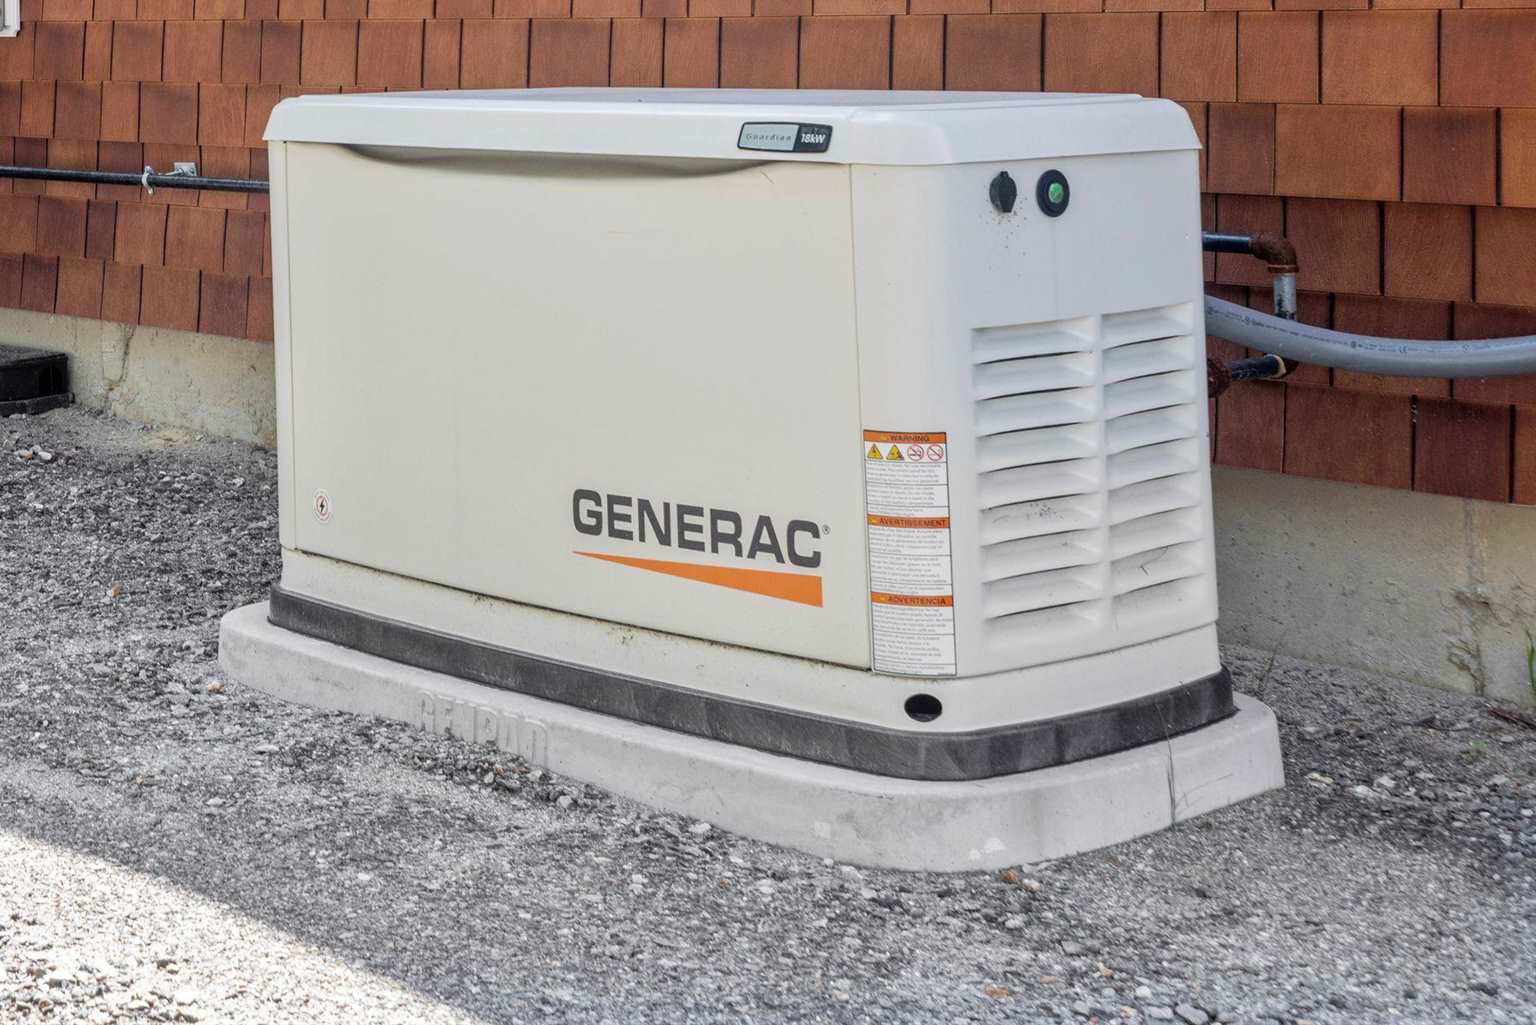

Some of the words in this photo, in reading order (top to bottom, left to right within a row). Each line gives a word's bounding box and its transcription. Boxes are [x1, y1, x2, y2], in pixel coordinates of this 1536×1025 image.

[745, 133, 792, 142] Guardian
[800, 133, 826, 144] 18kW
[889, 434, 930, 443] WARNING
[879, 517, 946, 528] AVERTISSEMENT
[572, 488, 823, 569] GENERAC
[887, 596, 946, 606] ADVERTENCIA
